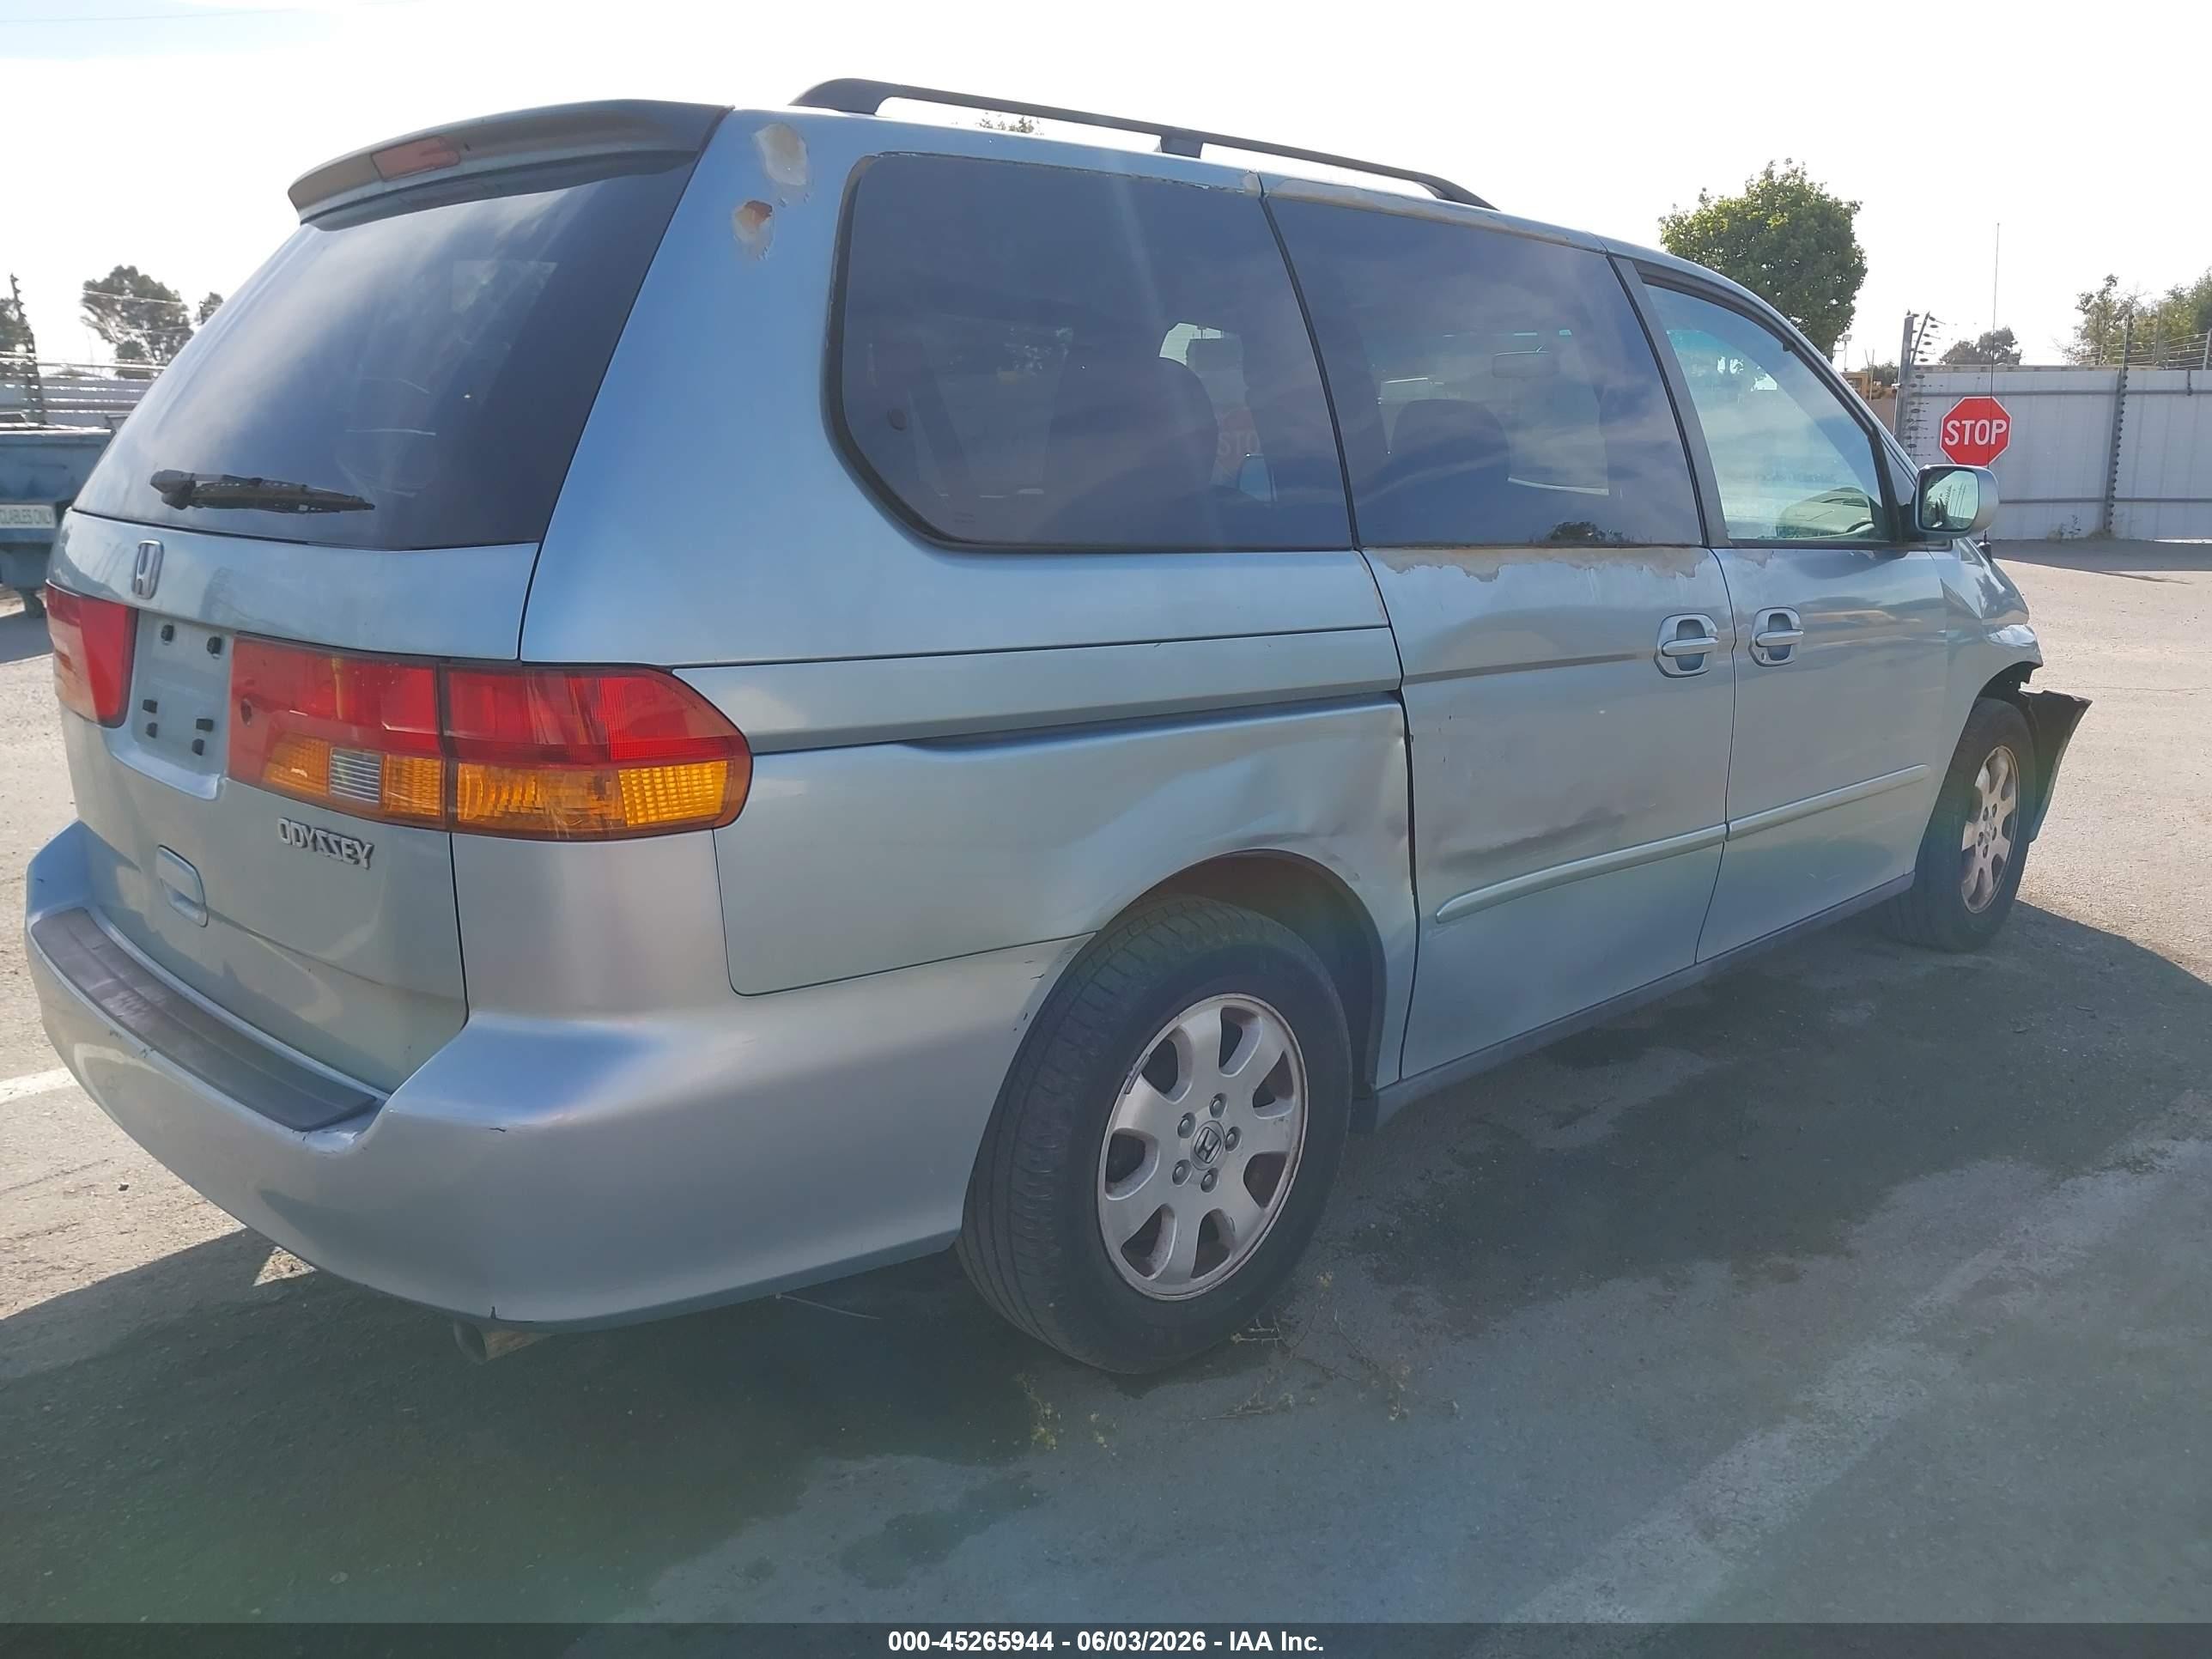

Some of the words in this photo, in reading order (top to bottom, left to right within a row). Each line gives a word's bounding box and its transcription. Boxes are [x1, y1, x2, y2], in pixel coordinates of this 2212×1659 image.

[1217, 430, 1261, 455] STO
[1944, 419, 2008, 447] STOP
[276, 817, 374, 870] ODYSSEY
